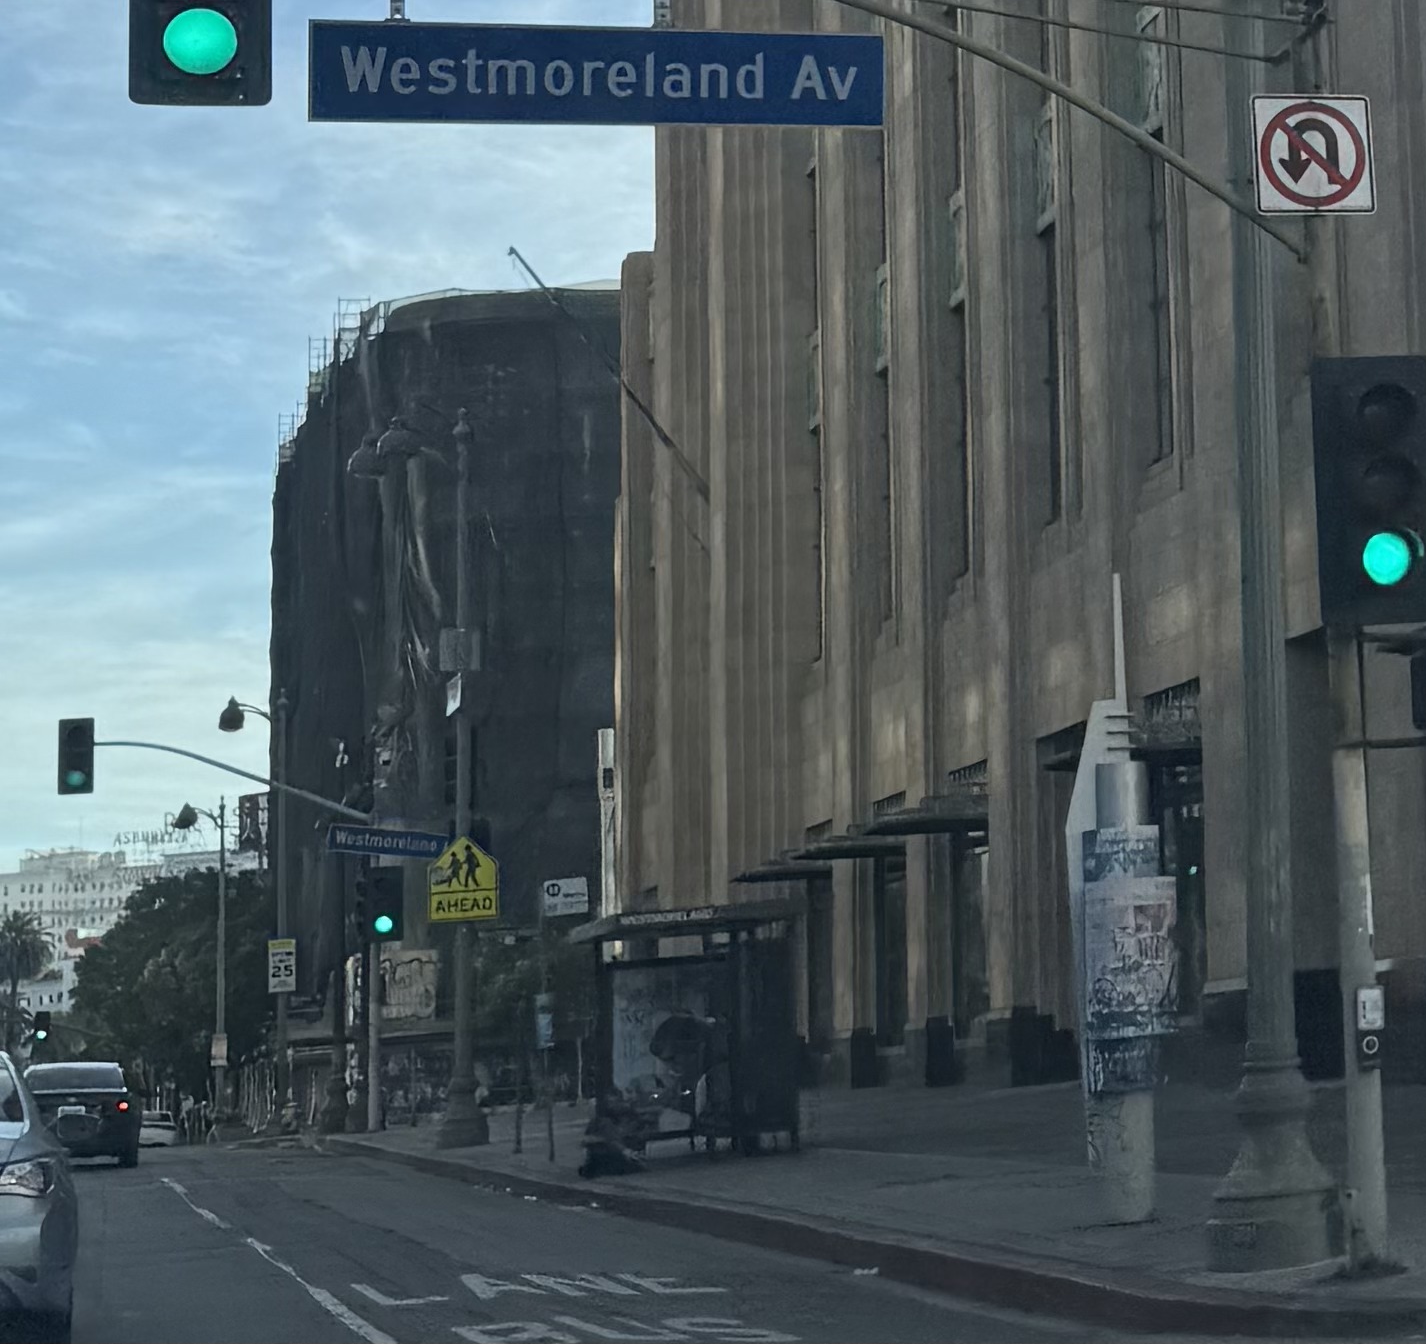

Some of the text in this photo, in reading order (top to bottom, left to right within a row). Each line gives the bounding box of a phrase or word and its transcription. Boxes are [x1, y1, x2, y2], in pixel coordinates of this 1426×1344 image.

[340, 45, 858, 102] Westmoreland Av
[435, 896, 492, 913] AHEAD
[272, 964, 293, 978] 25
[350, 1272, 728, 1306] LANE
[451, 1314, 801, 1344] BUS
